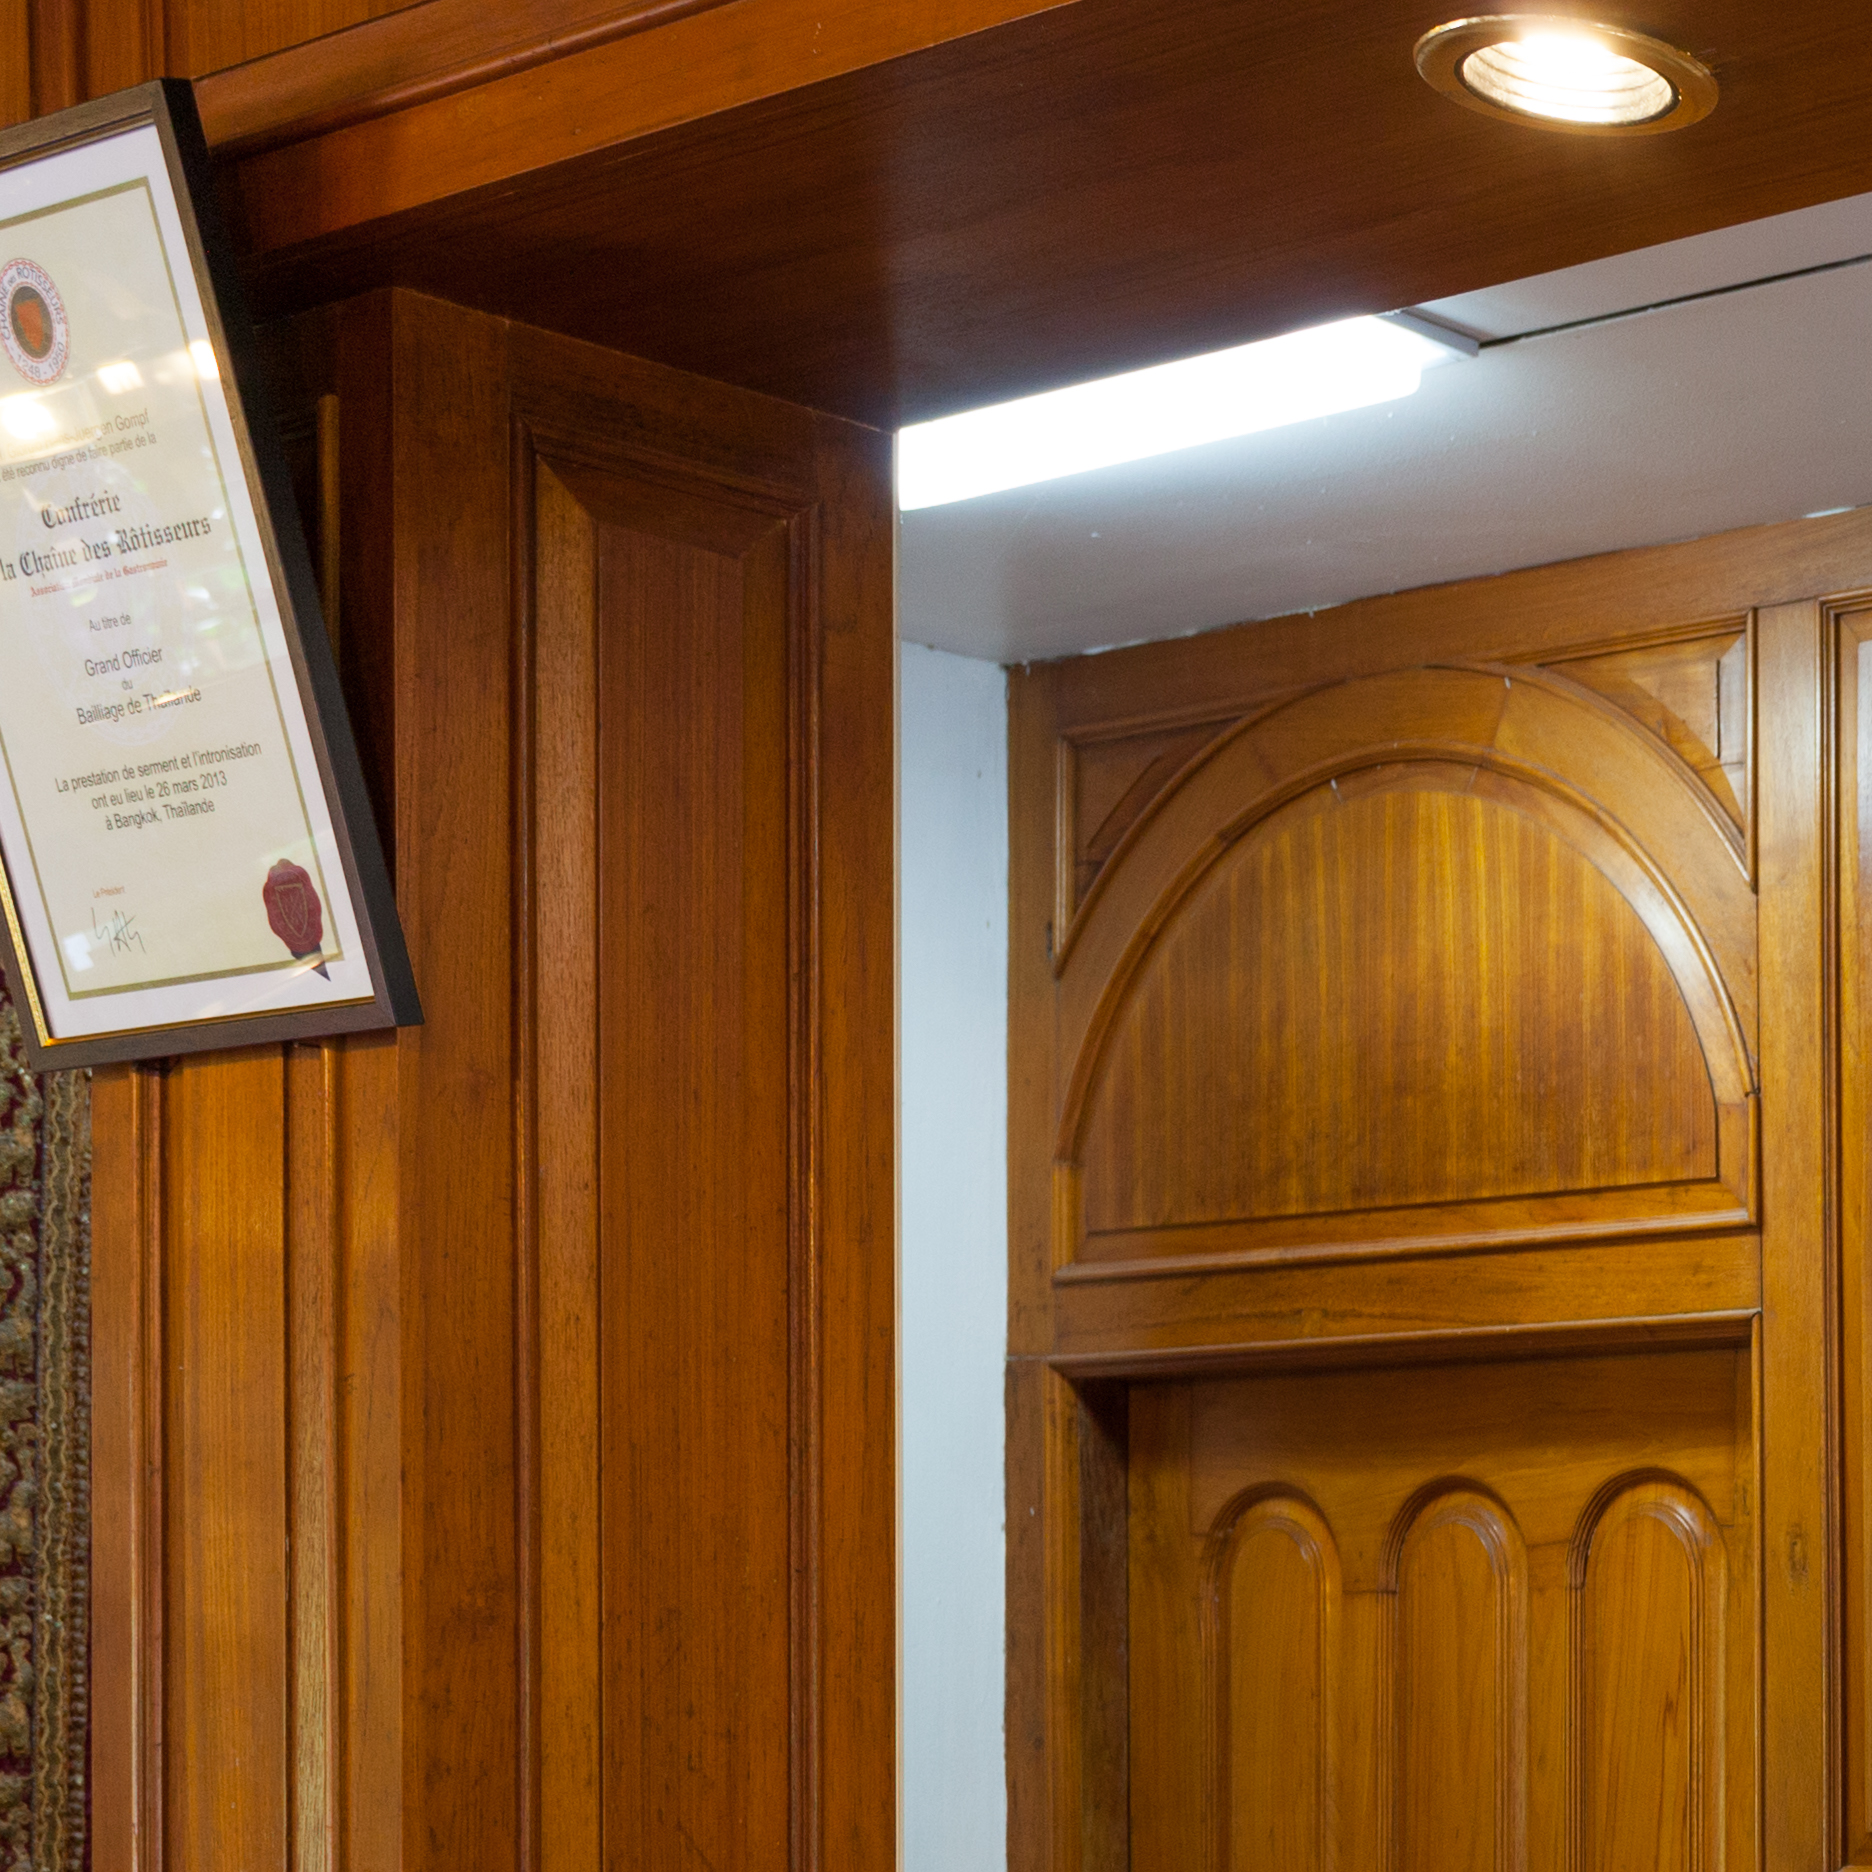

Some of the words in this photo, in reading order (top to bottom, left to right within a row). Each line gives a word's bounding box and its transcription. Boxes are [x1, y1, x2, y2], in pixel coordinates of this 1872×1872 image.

[115, 408, 150, 431] Gompf
[16, 460, 51, 477] reconnu
[51, 454, 76, 471] digne
[76, 449, 88, 463] de
[109, 437, 134, 458] partie
[135, 434, 147, 447] de
[147, 431, 157, 445] la
[41, 489, 122, 529] Confrérie
[19, 546, 78, 578] Chaîne
[81, 538, 111, 562] des
[116, 516, 212, 554] Rôtisseurs
[89, 618, 101, 632] Au
[102, 615, 119, 629] titre
[119, 612, 131, 625] de
[84, 653, 120, 677] Grand
[121, 646, 163, 669] Officier
[121, 677, 133, 691] du
[76, 700, 125, 725] Bailliage
[127, 697, 143, 714] de
[55, 777, 69, 793] La
[71, 769, 121, 793] prestation
[122, 764, 136, 780] de
[137, 756, 180, 777] serment
[181, 753, 193, 770] et
[192, 741, 262, 767] l'intronisation
[92, 793, 108, 809] ont
[110, 790, 124, 806] eu
[124, 785, 144, 804] lieu
[144, 784, 156, 800] le
[156, 781, 171, 798] 26
[173, 777, 199, 794] mars
[200, 770, 228, 789] 2013
[105, 815, 113, 831] à
[115, 809, 162, 829] Bangkok,
[163, 799, 215, 821] Thaïlande
